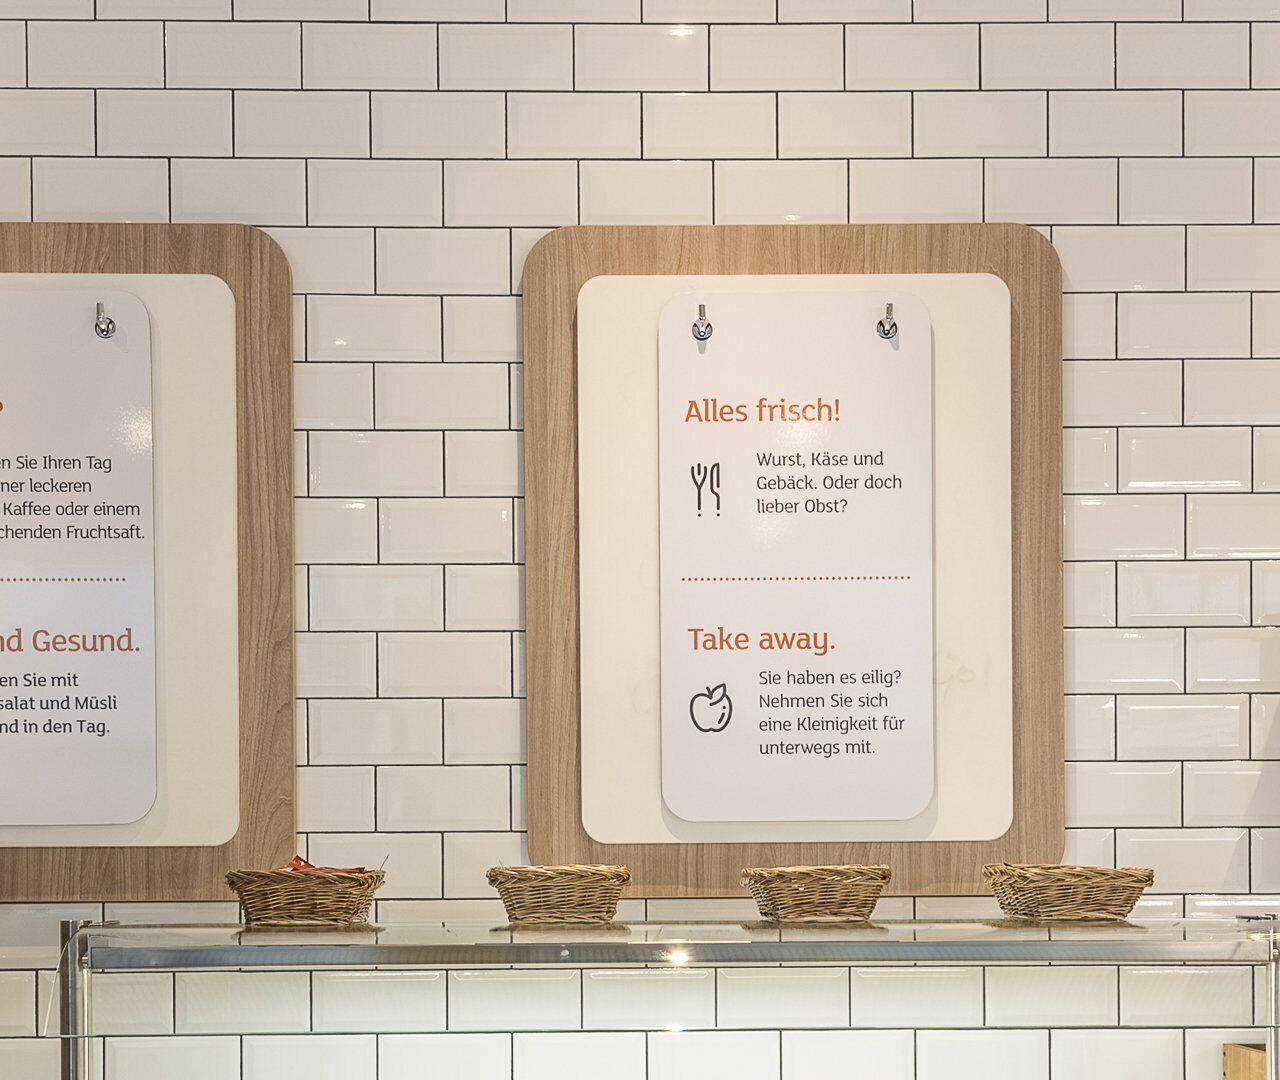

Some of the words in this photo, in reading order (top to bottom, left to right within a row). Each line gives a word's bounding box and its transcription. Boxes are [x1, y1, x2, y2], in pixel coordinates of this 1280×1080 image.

[684, 398, 748, 423] Alles
[755, 397, 840, 422] frisch!
[16, 455, 38, 470] Sie
[42, 454, 82, 470] Ihren
[85, 455, 112, 474] Tag
[756, 452, 806, 469] Wurst,
[811, 452, 849, 466] Käse
[853, 450, 884, 466] und
[29, 477, 92, 493] leckeren
[756, 474, 819, 490] Gebäck.
[822, 474, 860, 490] Oder
[864, 474, 902, 490] doch
[3, 500, 51, 516] Kaffee
[55, 501, 90, 516] oder
[93, 501, 141, 516] einem
[756, 498, 800, 514] lieber
[804, 498, 848, 514] Obst?
[66, 523, 145, 539] Fruchtsaft.
[32, 627, 140, 653] Gesund.
[687, 626, 750, 651] Take
[759, 631, 836, 657] away.
[22, 672, 47, 687] Sie
[50, 672, 79, 687] mit
[759, 670, 782, 685] Sie
[787, 669, 835, 685] haben
[839, 673, 857, 685] es
[861, 669, 902, 688] eilig?
[39, 695, 71, 710] und
[75, 695, 118, 710] Müsli
[759, 693, 825, 709] Nehmen
[830, 692, 853, 708] Sie
[858, 692, 888, 708] sich
[22, 719, 39, 734] in
[42, 718, 73, 734] den
[76, 719, 110, 737] Tag.
[758, 717, 792, 732] eine
[797, 715, 878, 735] Kleinigkeit
[882, 715, 905, 731] für
[759, 740, 841, 759] unterwegs
[844, 739, 876, 754] mit.
